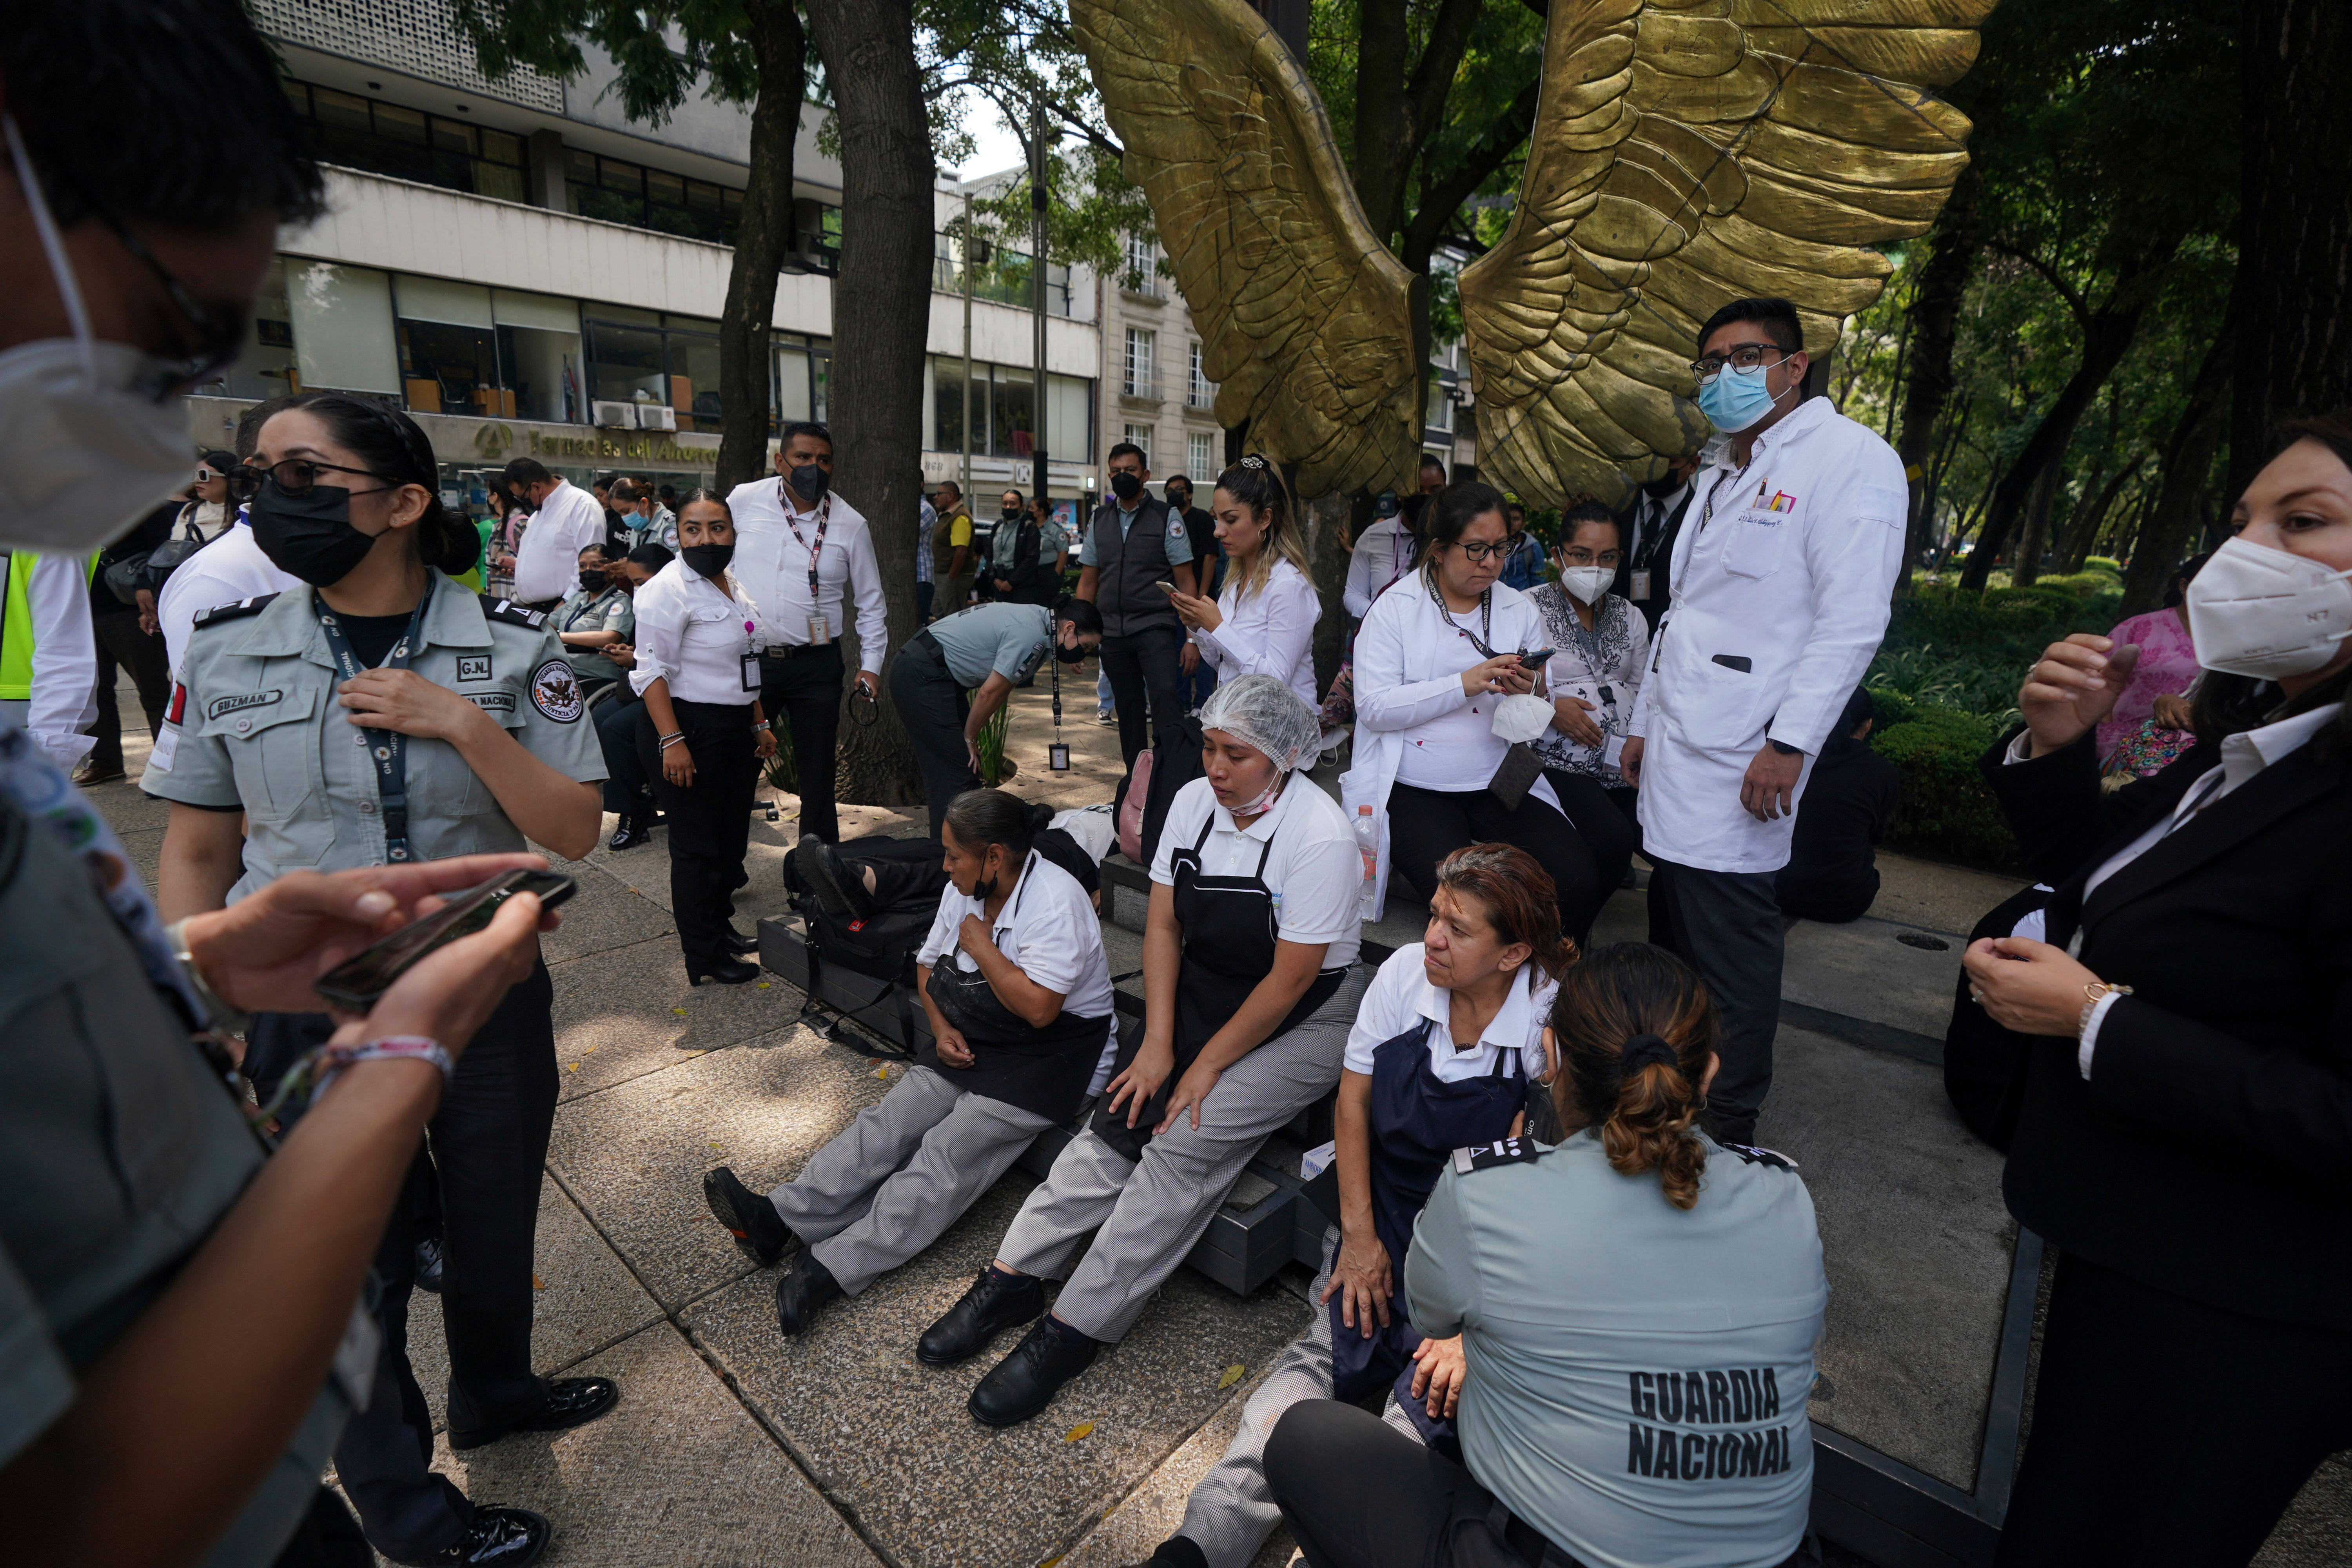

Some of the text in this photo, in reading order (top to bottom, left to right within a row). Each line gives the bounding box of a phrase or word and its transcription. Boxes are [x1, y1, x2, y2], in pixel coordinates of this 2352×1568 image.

[529, 430, 719, 462] Farmacias del Ahorro
[925, 461, 943, 470] 868
[340, 651, 356, 678] CIONAL
[461, 661, 487, 675] G.N.
[218, 694, 267, 712] GUZMAN
[480, 696, 513, 707] NACIONAL
[544, 704, 570, 717] JUSTICIA
[1629, 1367, 1780, 1425] GUARDIA
[1628, 1422, 1791, 1481] NACIONAL
